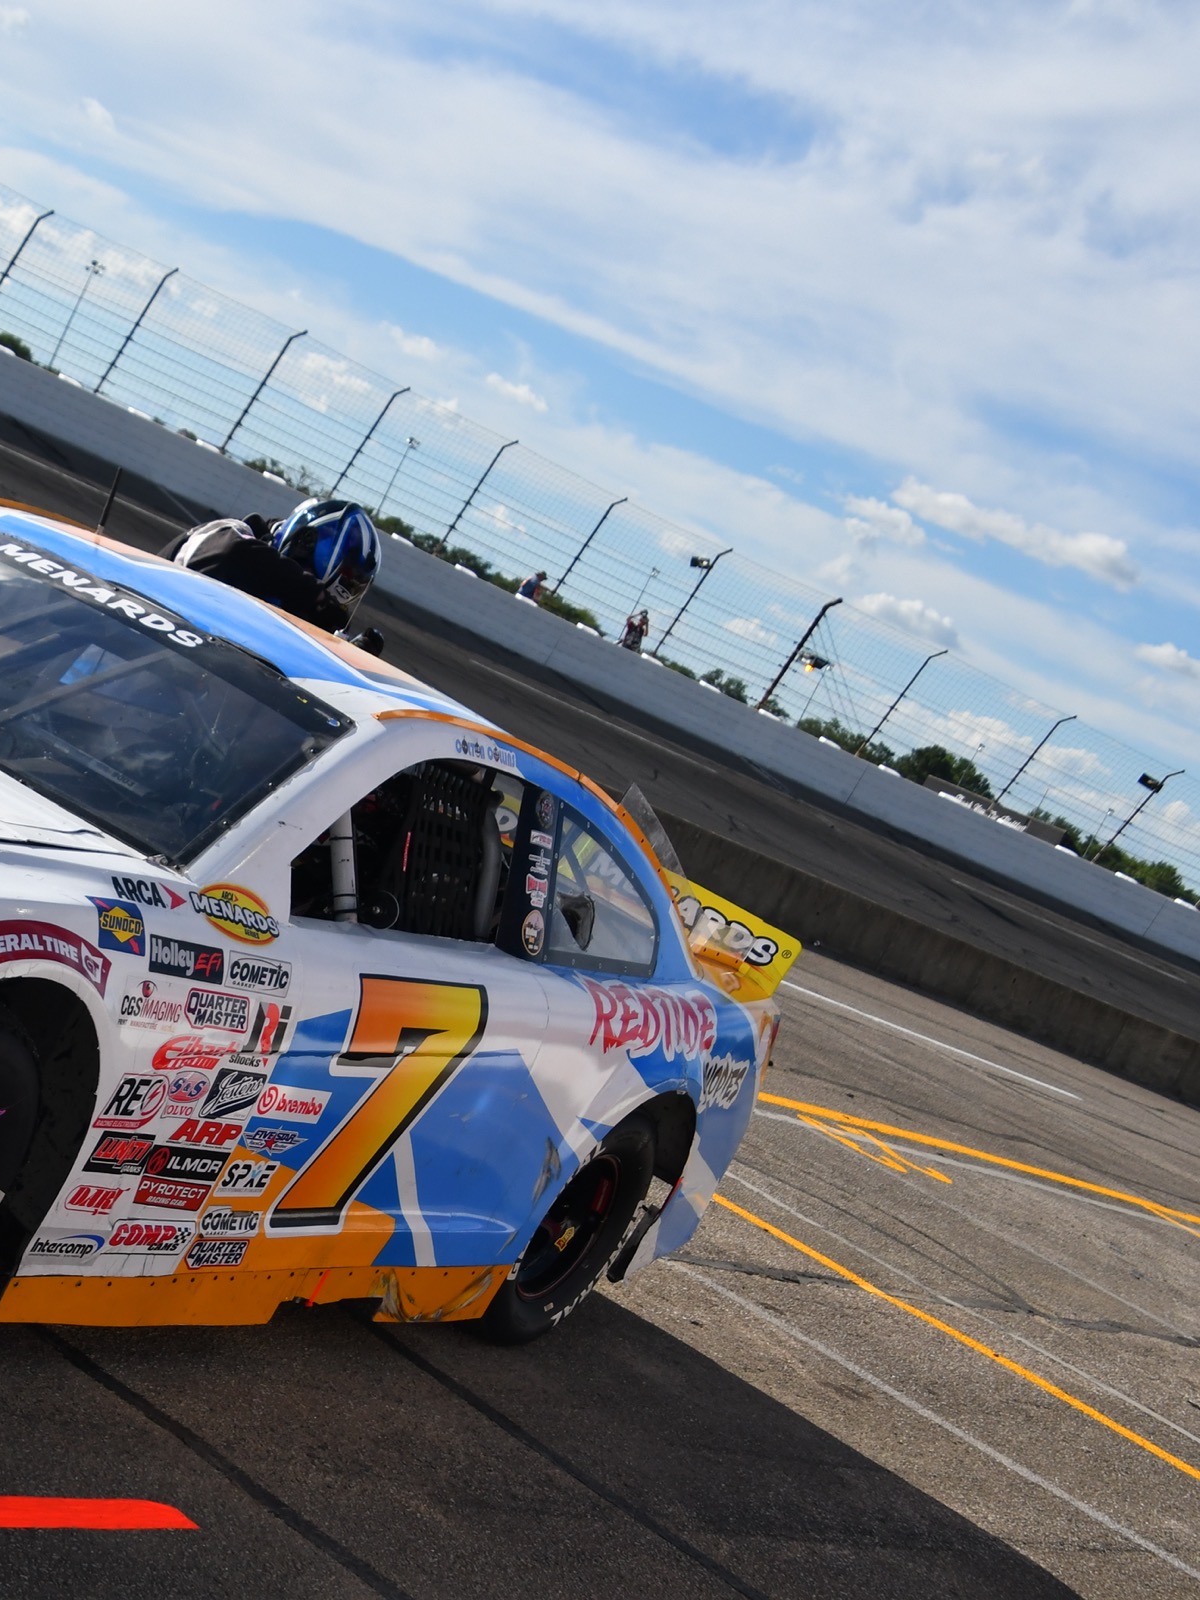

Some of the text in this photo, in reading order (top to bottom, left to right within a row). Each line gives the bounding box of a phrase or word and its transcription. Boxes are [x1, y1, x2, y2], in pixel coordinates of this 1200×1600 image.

[111, 876, 166, 908] ARCA
[221, 890, 234, 901] ARCA
[101, 914, 143, 936] SUNOCO
[189, 891, 280, 938] MENARDS
[42, 935, 80, 963] TIRE
[151, 937, 195, 976] Holley
[230, 960, 290, 989] COMETIC
[187, 991, 248, 1016] QUARTER
[194, 1007, 246, 1030] MASTER
[228, 1052, 263, 1068] shocks
[170, 1077, 207, 1097] S&S
[269, 973, 490, 1228] 7
[275, 1095, 323, 1116] brembo
[168, 1118, 243, 1146] ARP
[253, 1130, 297, 1142] FIVE STAR
[166, 1155, 223, 1174] ILMOR
[138, 1180, 206, 1199] PYROTECT
[146, 1195, 187, 1207] RACING GEAR
[201, 1211, 259, 1231] COMETIC
[109, 1223, 177, 1247] COMP
[29, 1237, 94, 1259] Intercomp
[147, 1242, 180, 1252] CAMS
[187, 1241, 247, 1260] QUARTER
[192, 1252, 243, 1267] MASTER
